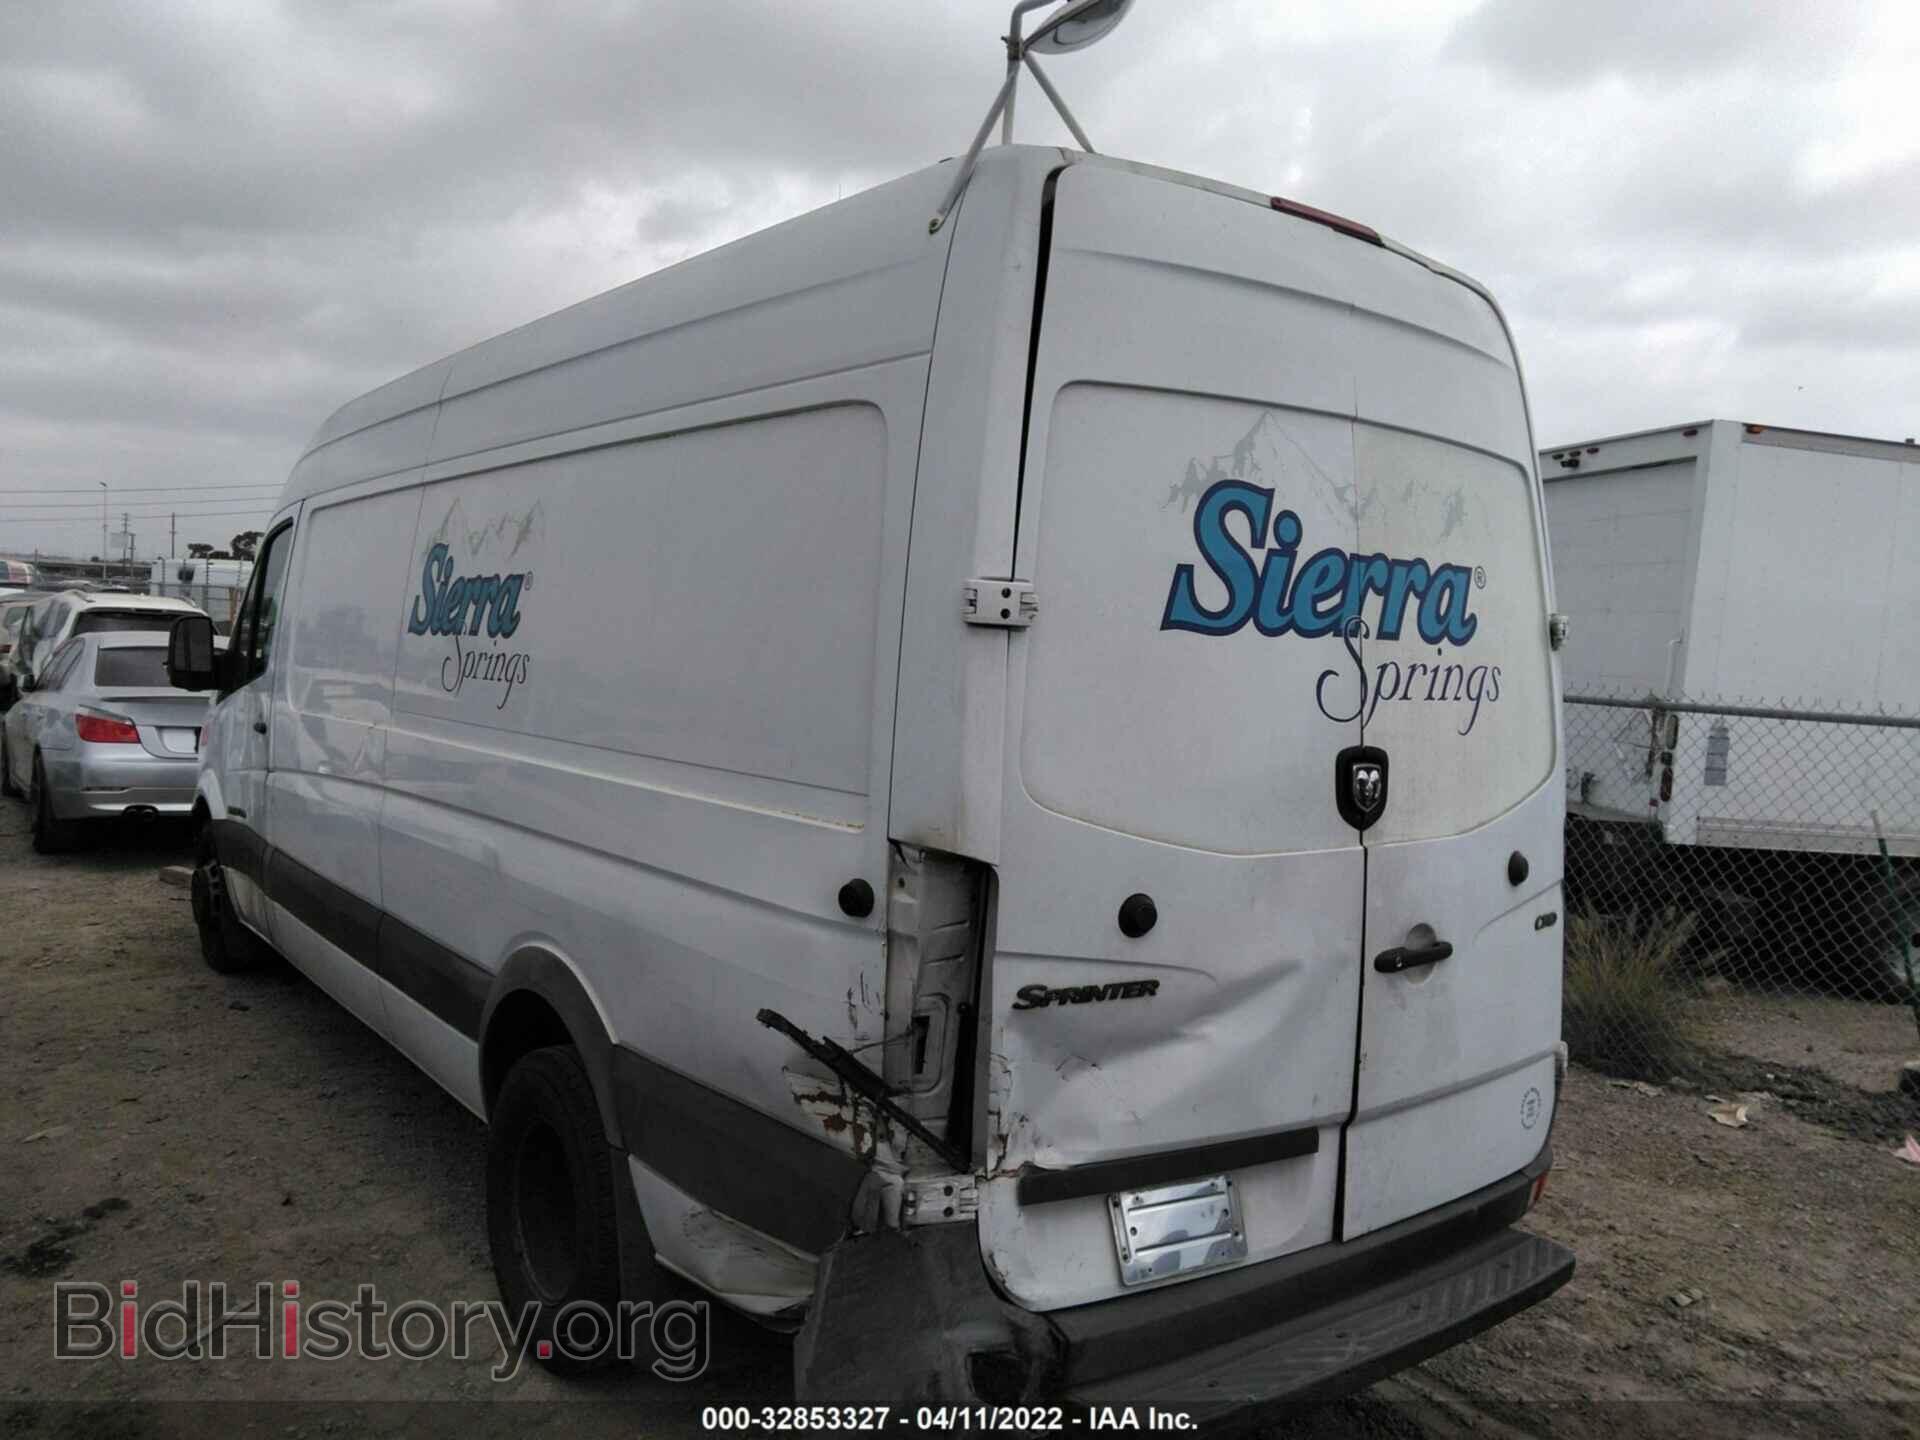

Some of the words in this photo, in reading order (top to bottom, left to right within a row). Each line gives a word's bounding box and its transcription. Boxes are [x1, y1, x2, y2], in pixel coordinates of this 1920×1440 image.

[408, 543, 525, 639] Sierra
[1160, 479, 1477, 646] Sierra
[441, 622, 530, 709] Springs
[1316, 615, 1501, 736] Springs
